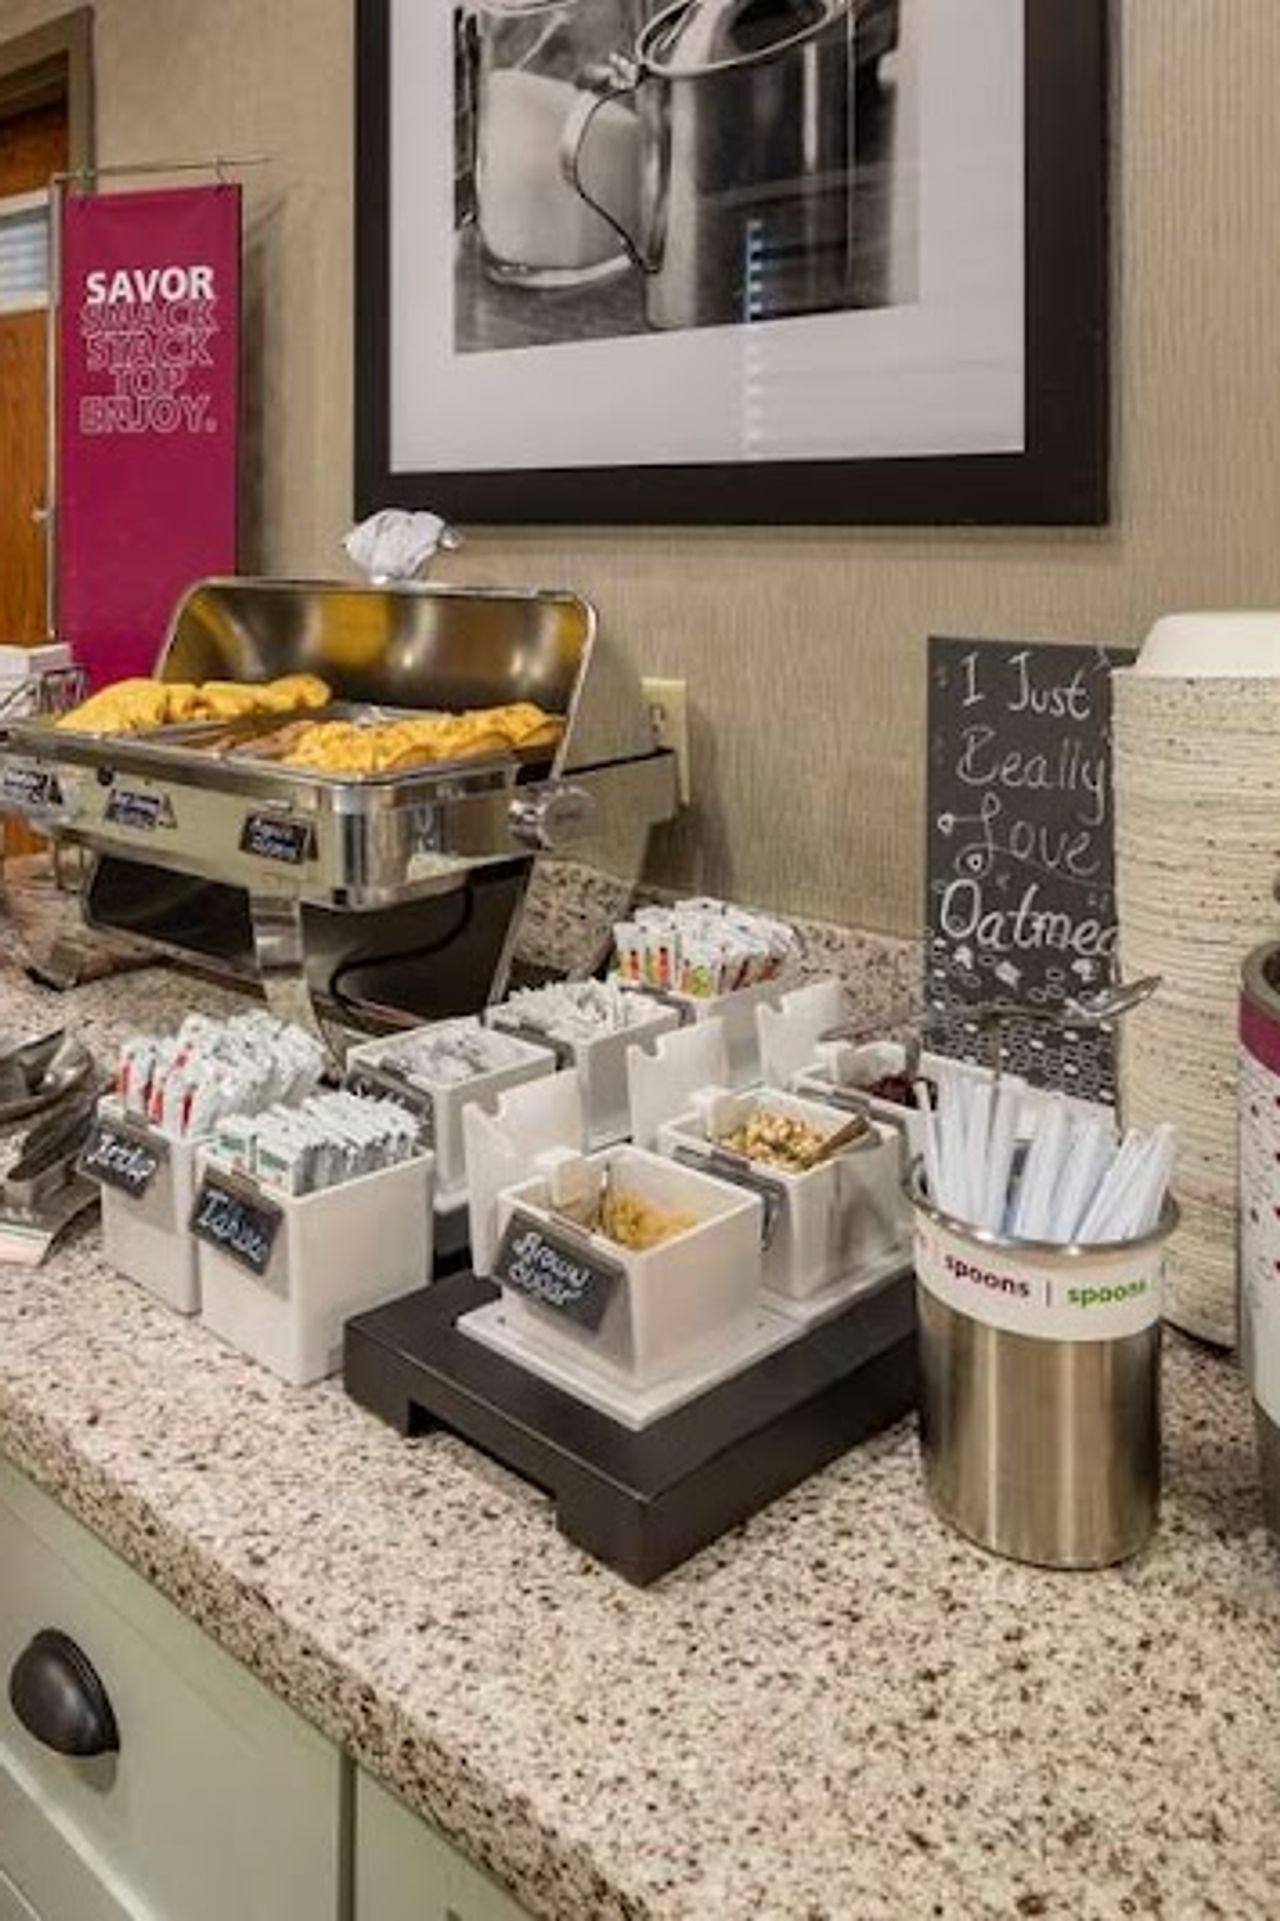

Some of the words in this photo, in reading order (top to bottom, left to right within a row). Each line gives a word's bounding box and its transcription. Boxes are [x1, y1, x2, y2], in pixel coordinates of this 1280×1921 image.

[86, 265, 215, 304] SAVOR
[86, 327, 214, 372] STACK
[109, 362, 188, 400] TOP
[79, 395, 218, 434] ENJOY.
[960, 652, 986, 706] I
[1007, 651, 1090, 721] Just
[956, 724, 1105, 826] Really
[938, 792, 1101, 879] Love
[940, 878, 1119, 956] Oatmea
[945, 1254, 1029, 1298] spoons
